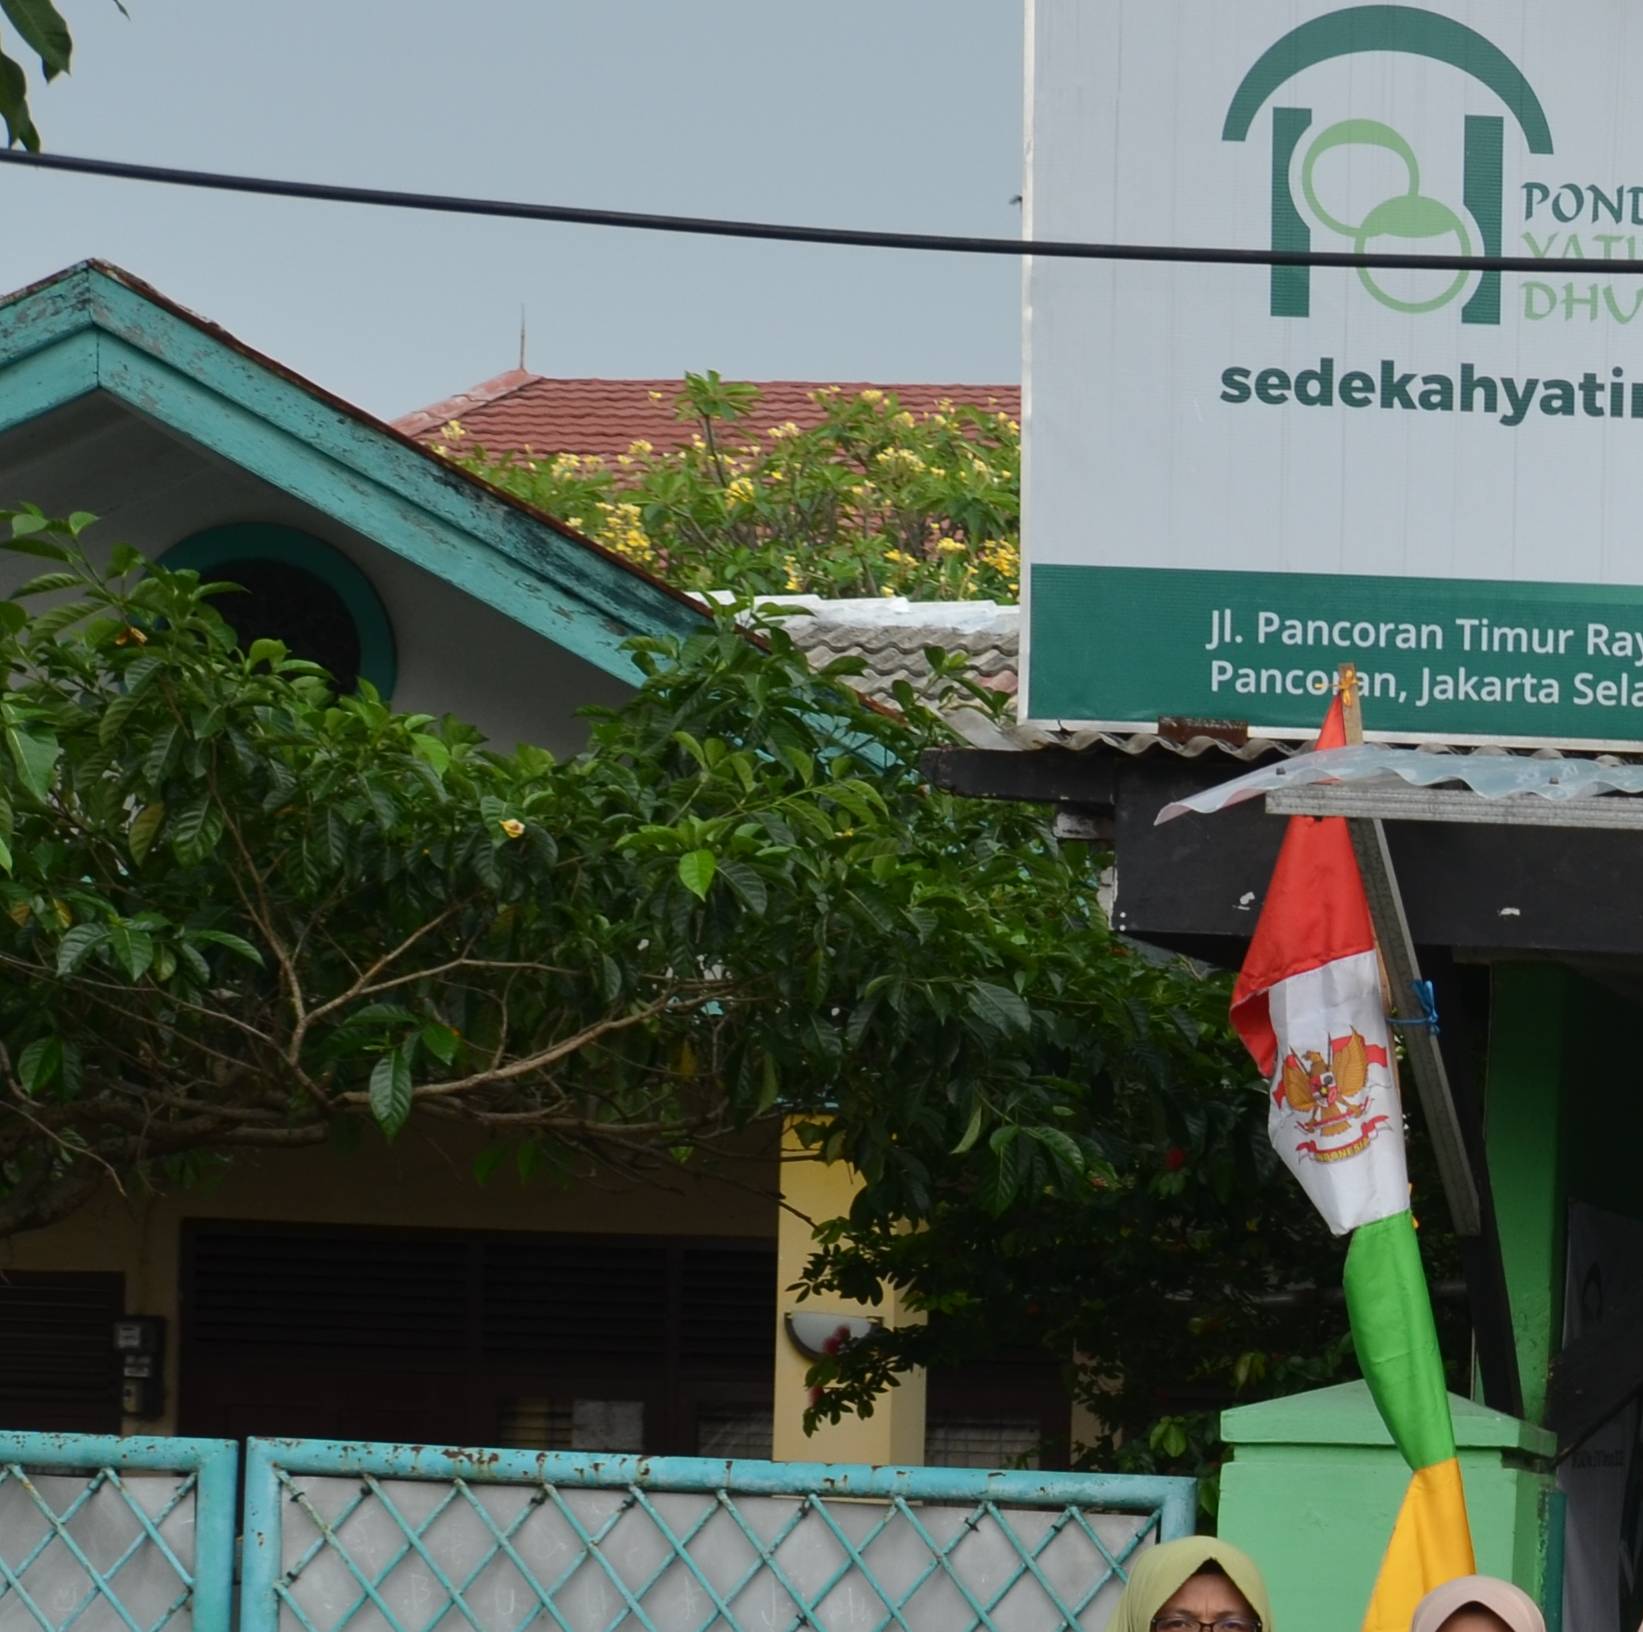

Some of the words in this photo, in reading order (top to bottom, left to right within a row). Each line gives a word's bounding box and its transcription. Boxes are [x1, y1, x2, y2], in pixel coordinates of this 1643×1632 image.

[1205, 608, 1244, 650] Jl.
[1258, 611, 1443, 650] Pancoran
[1455, 618, 1575, 654] Timur
[1415, 666, 1560, 707] Jakarta
